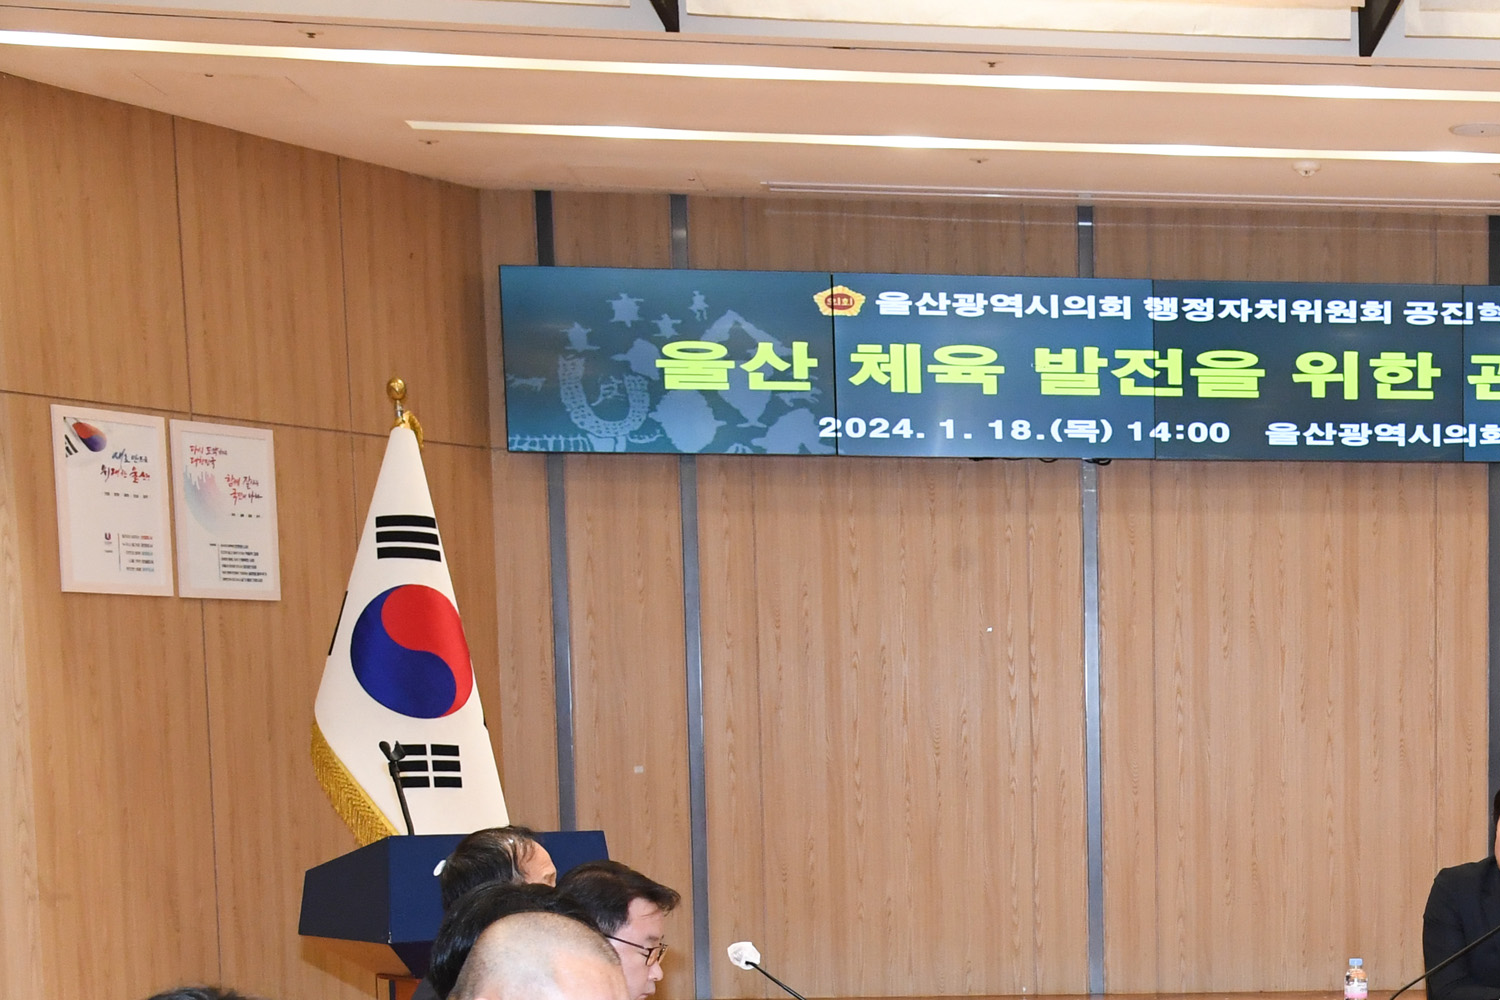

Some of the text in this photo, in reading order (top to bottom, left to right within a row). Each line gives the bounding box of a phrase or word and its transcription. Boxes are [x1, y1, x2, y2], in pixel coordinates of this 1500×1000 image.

[875, 291, 1130, 322] 울산광역시의회
[1143, 297, 1392, 325] 행정자치위원회
[656, 341, 818, 391] 울산
[851, 344, 1003, 395] 체육
[1034, 346, 1266, 399] 발전을
[1292, 350, 1442, 401] 위한
[818, 416, 925, 439] 2024.
[939, 418, 972, 440] 1.
[988, 418, 1113, 444] 18.(목)
[1127, 421, 1230, 443] 14:00
